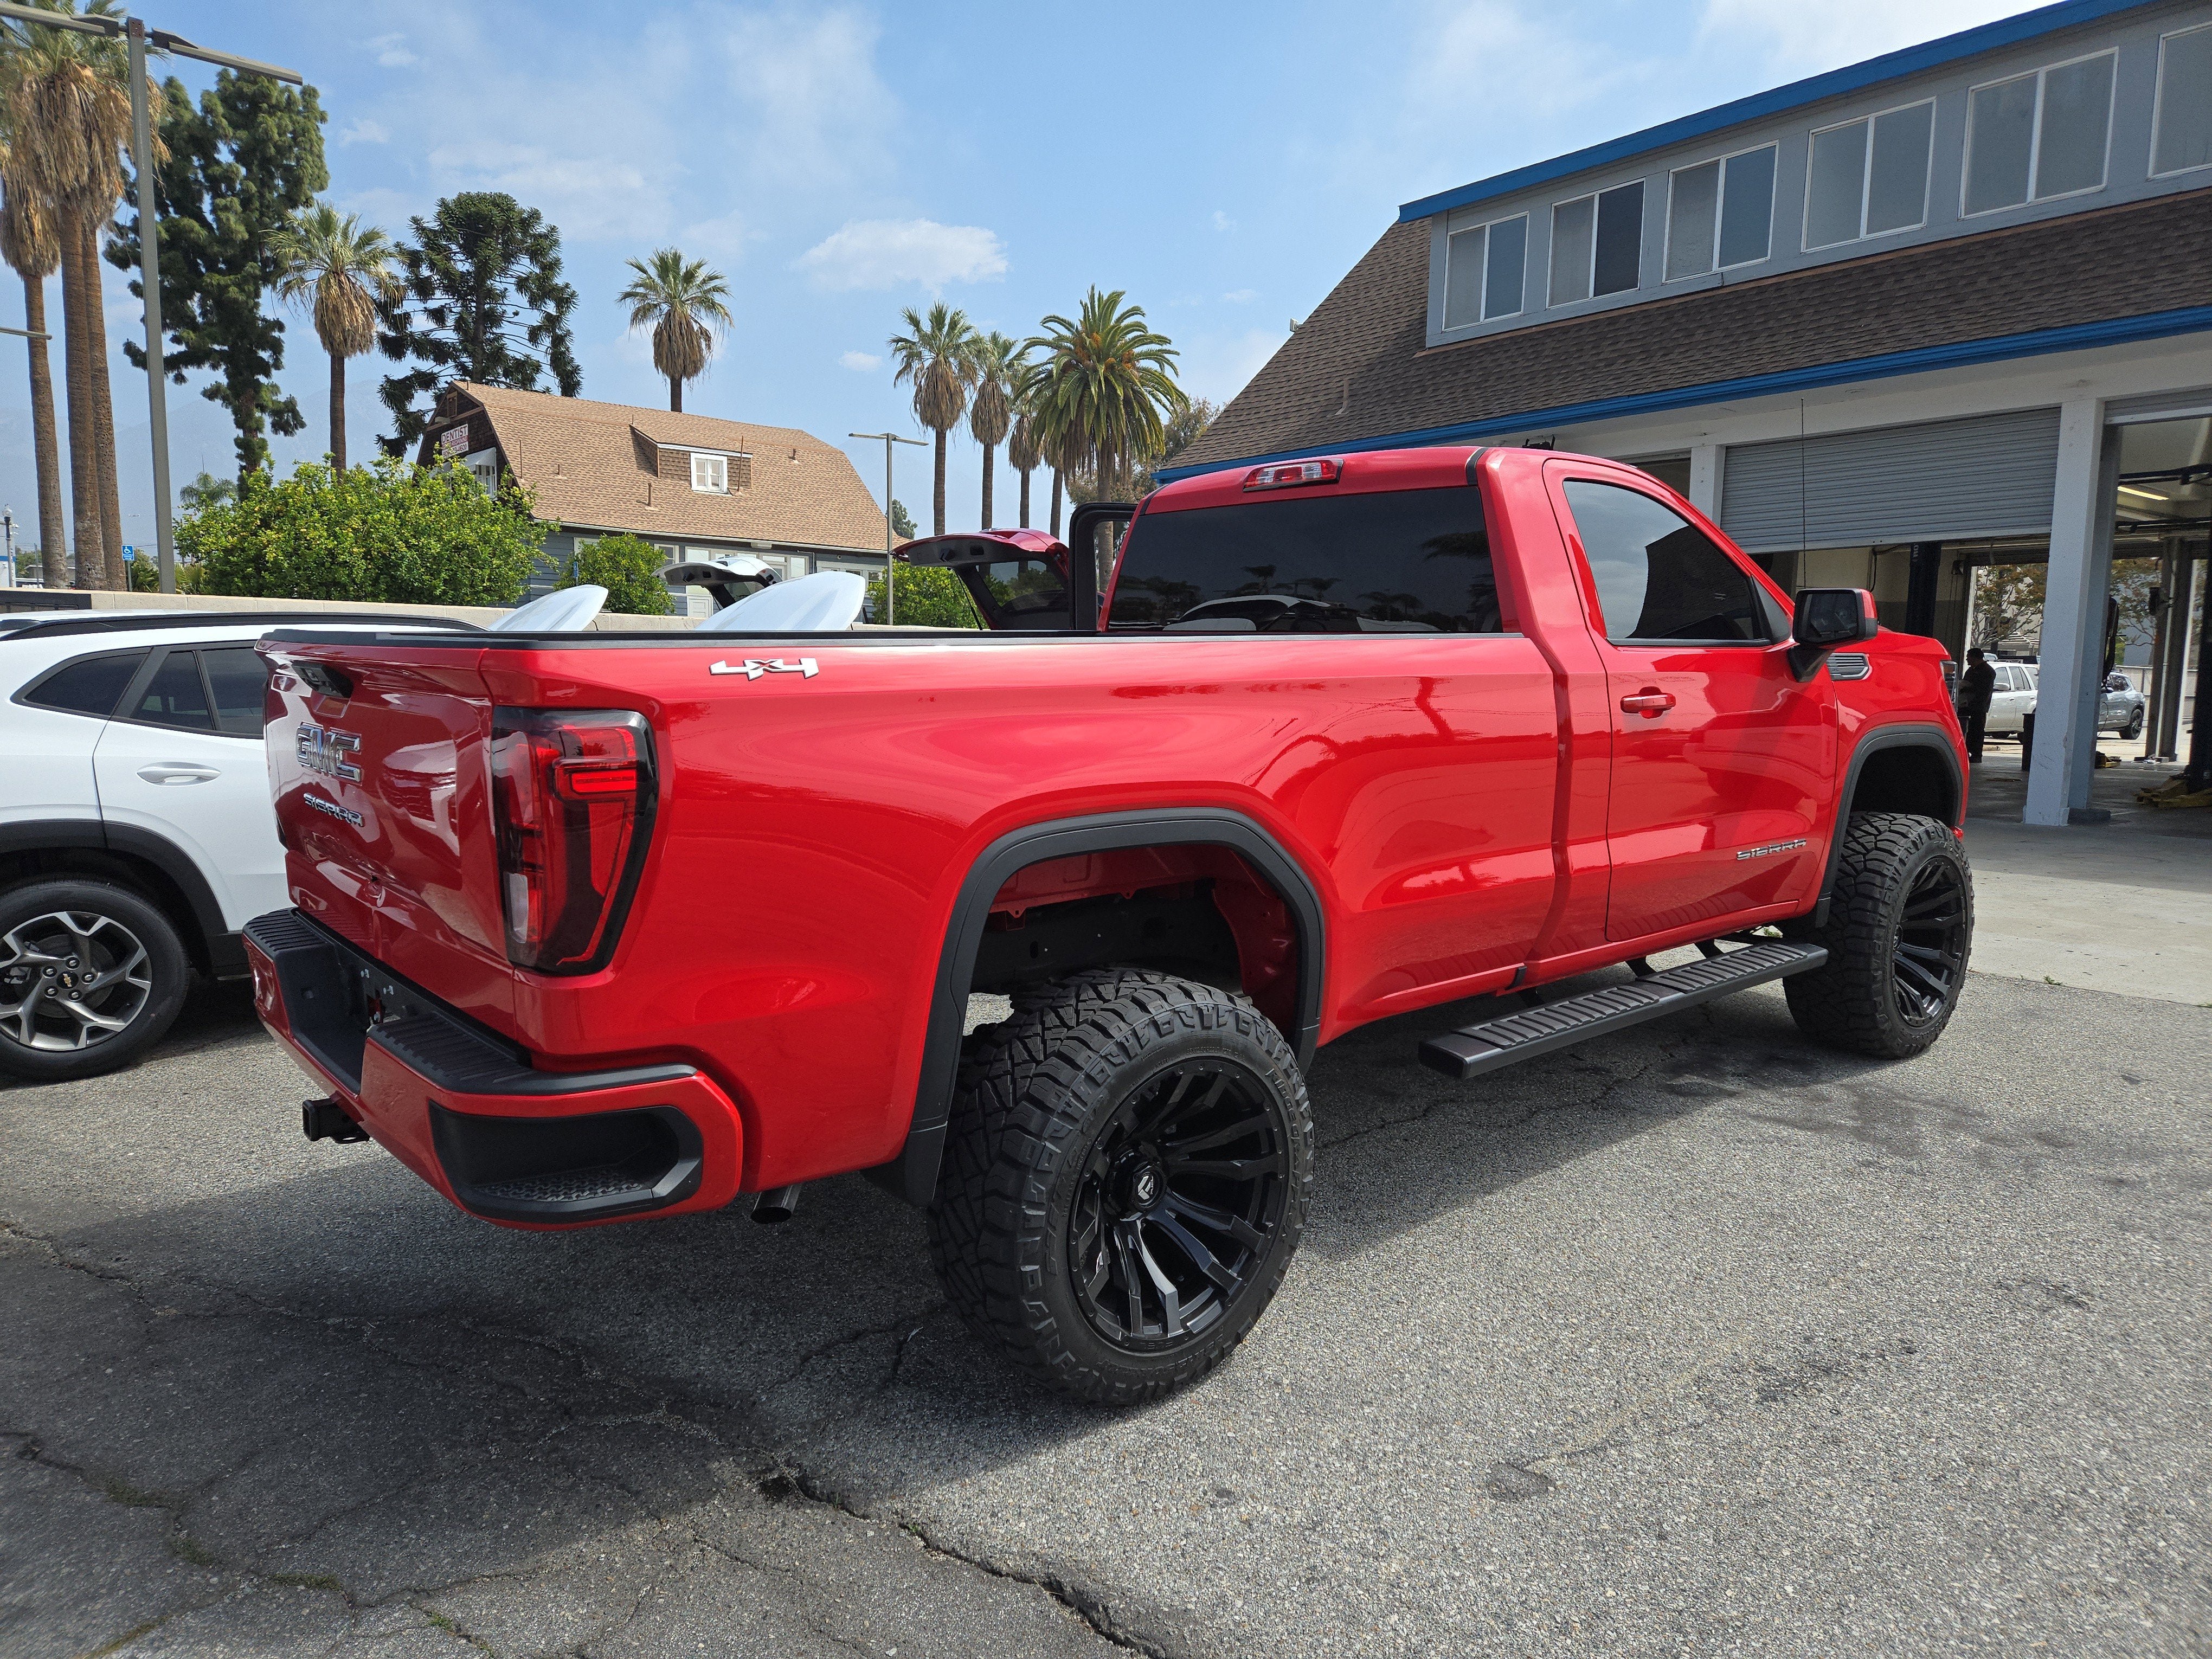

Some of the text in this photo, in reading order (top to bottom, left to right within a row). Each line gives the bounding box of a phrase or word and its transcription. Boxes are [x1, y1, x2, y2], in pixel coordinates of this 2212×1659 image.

[442, 426, 467, 443] DENTIST
[296, 724, 362, 783] GMC
[303, 792, 365, 827] SIERRA
[1737, 838, 1806, 860] SIERRA
